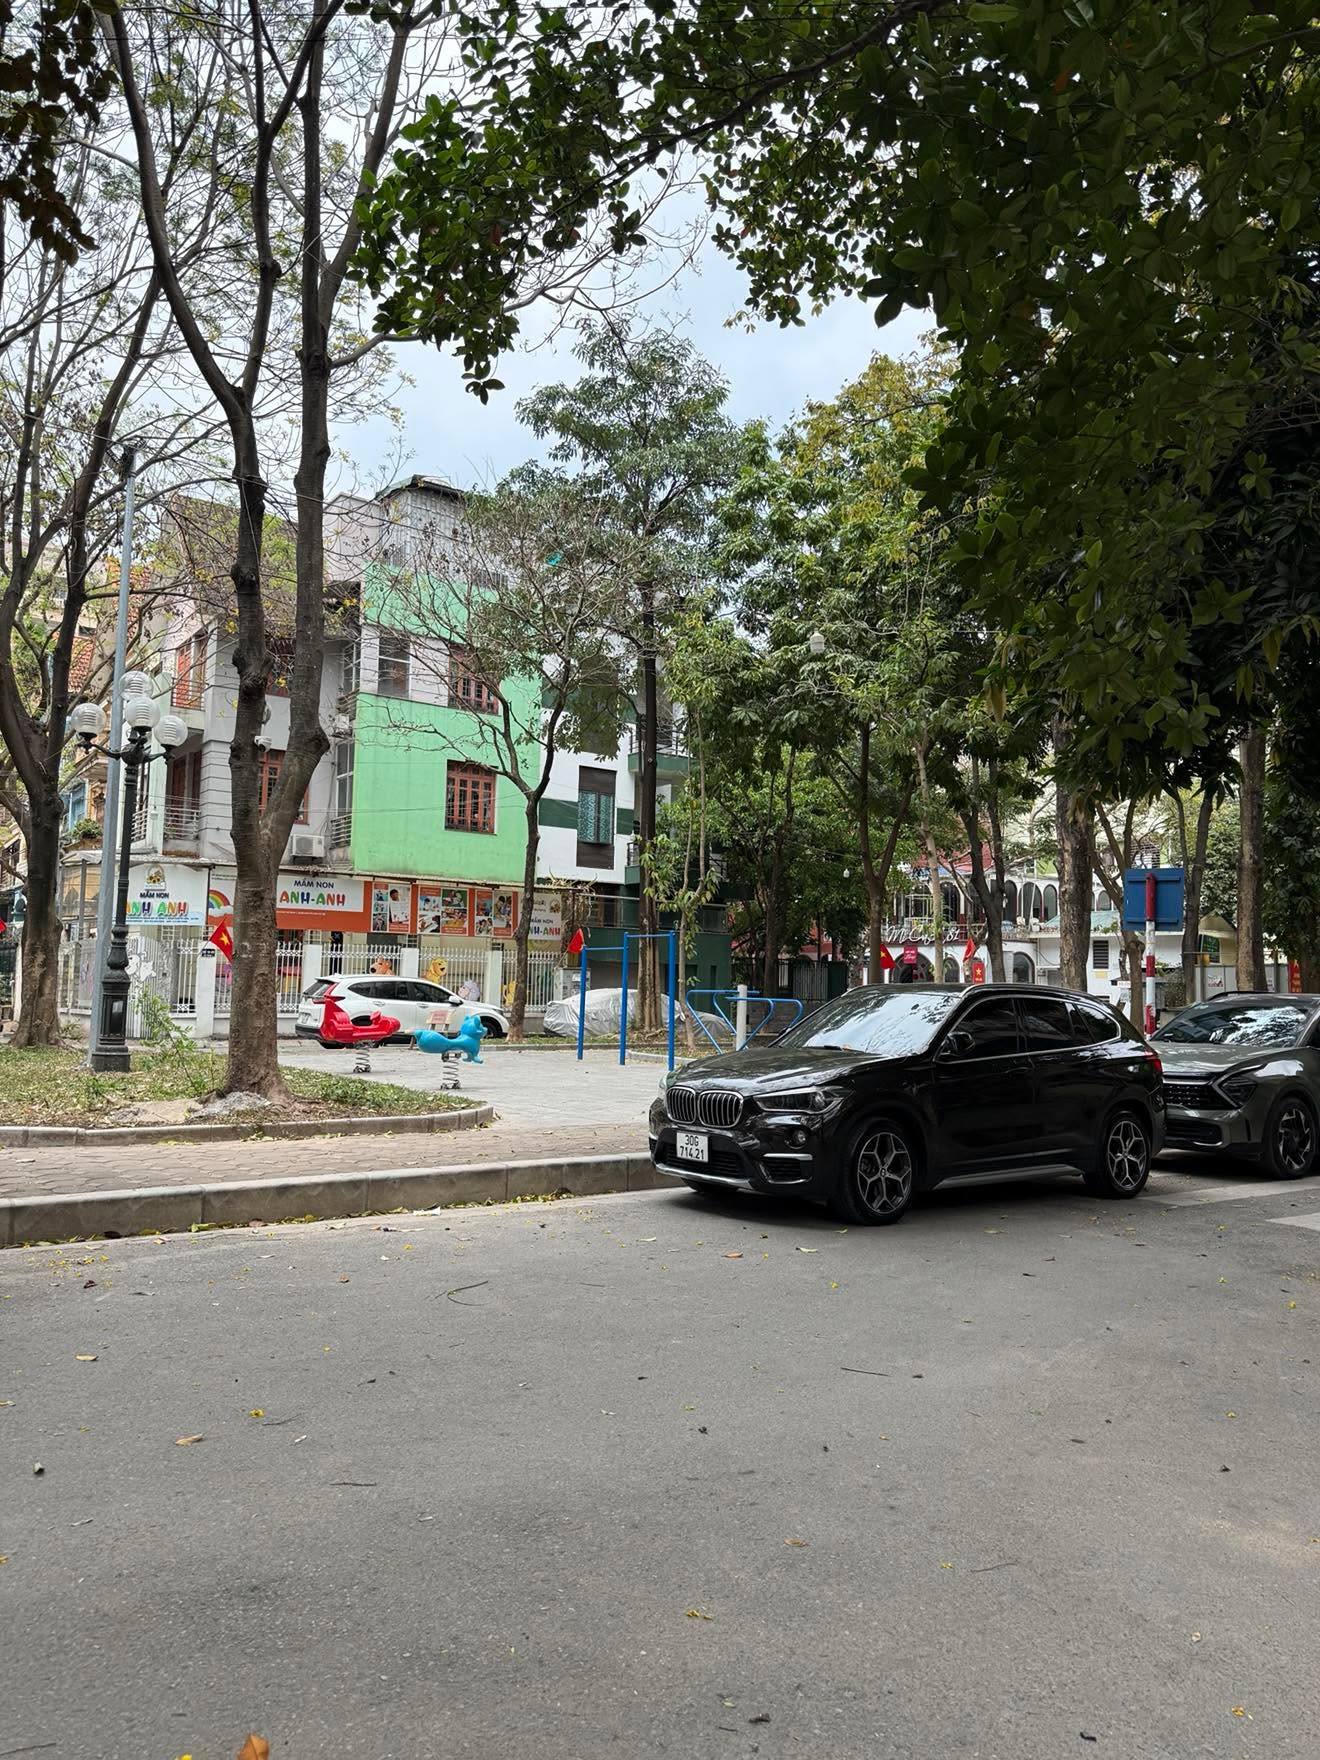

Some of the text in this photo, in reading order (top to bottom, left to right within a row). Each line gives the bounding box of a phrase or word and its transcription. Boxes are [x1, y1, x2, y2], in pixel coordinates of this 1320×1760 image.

[316, 881, 335, 889] NON
[279, 890, 346, 906] ANH-ANH
[157, 901, 188, 914] ANH
[685, 1135, 699, 1146] 30G
[680, 1145, 704, 1160] 714.21
